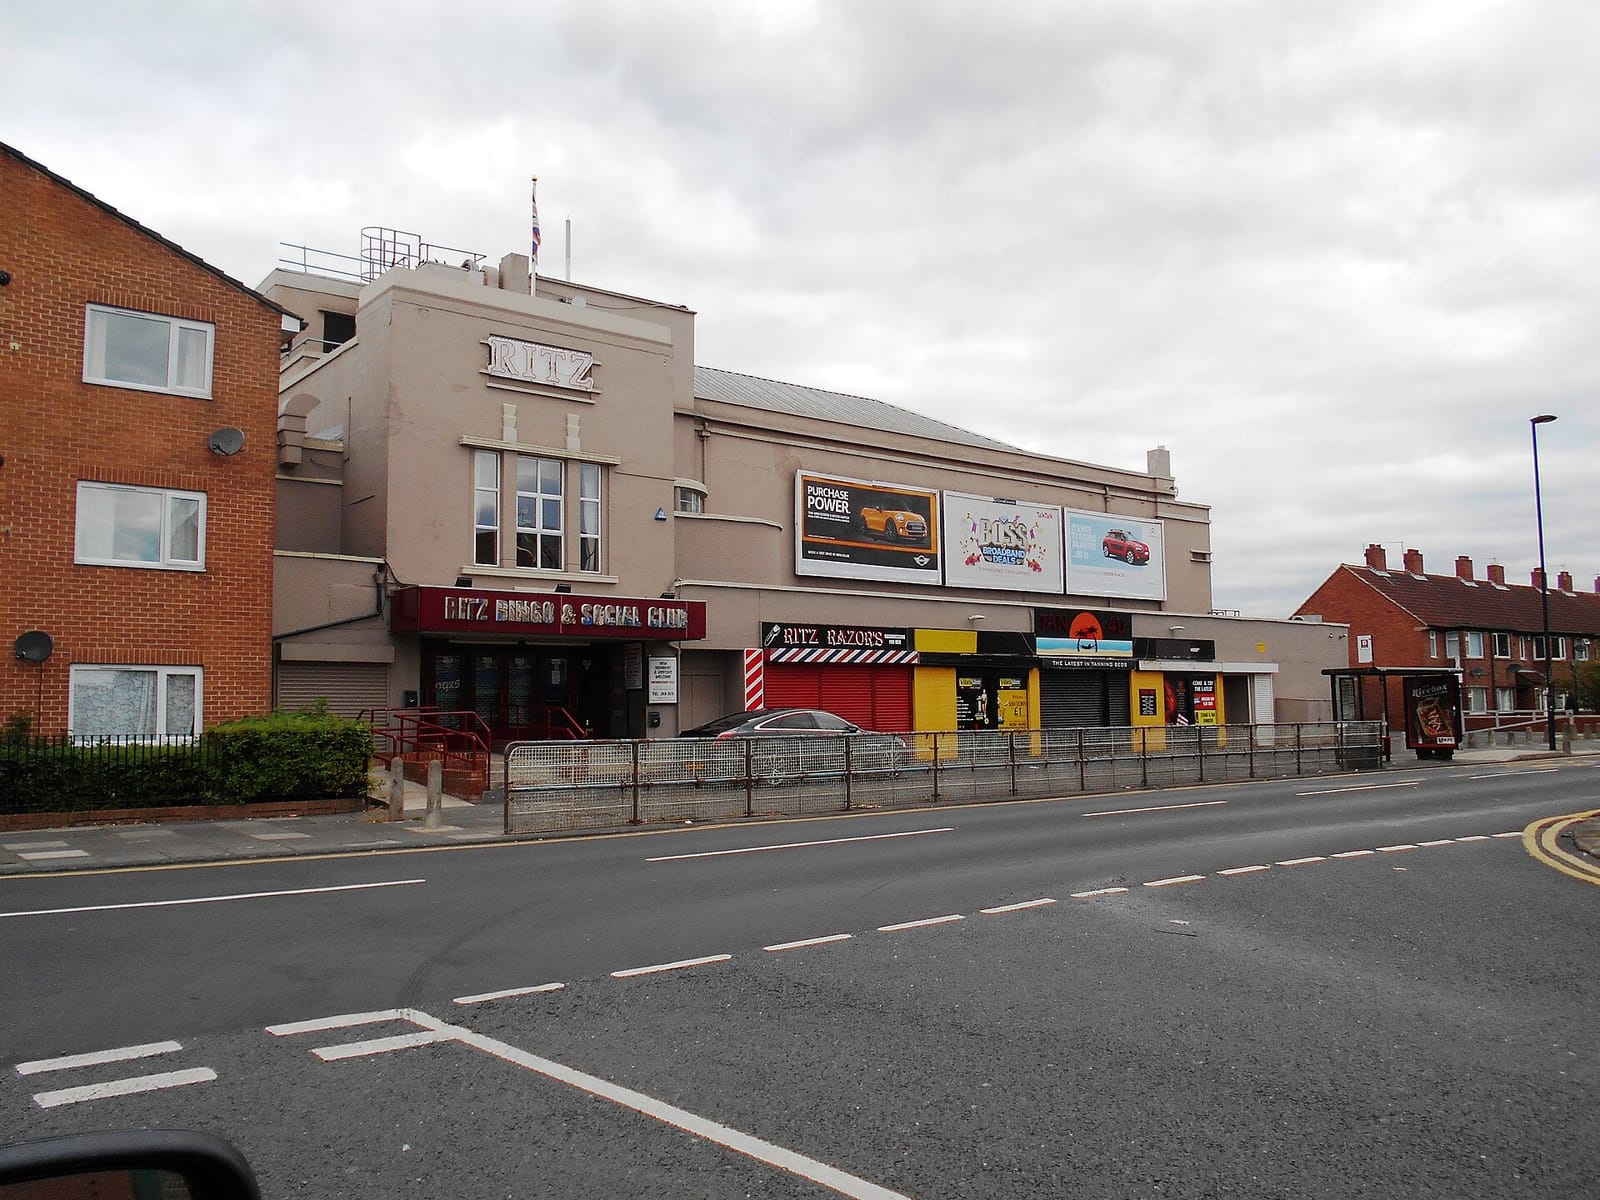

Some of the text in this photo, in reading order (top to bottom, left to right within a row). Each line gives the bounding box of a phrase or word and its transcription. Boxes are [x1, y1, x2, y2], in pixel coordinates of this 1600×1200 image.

[489, 338, 593, 390] RITZ
[807, 485, 849, 501] PURCHASE
[979, 517, 1028, 546] BOSS
[982, 546, 1026, 558] BROADBAND
[992, 555, 1017, 565] DEALS
[444, 596, 688, 628] RITZ BINGO & SOCIAL CLUB
[1040, 613, 1066, 632] TAN
[783, 627, 884, 647] RITZ RAZOR'S
[1013, 707, 1022, 716] £1
